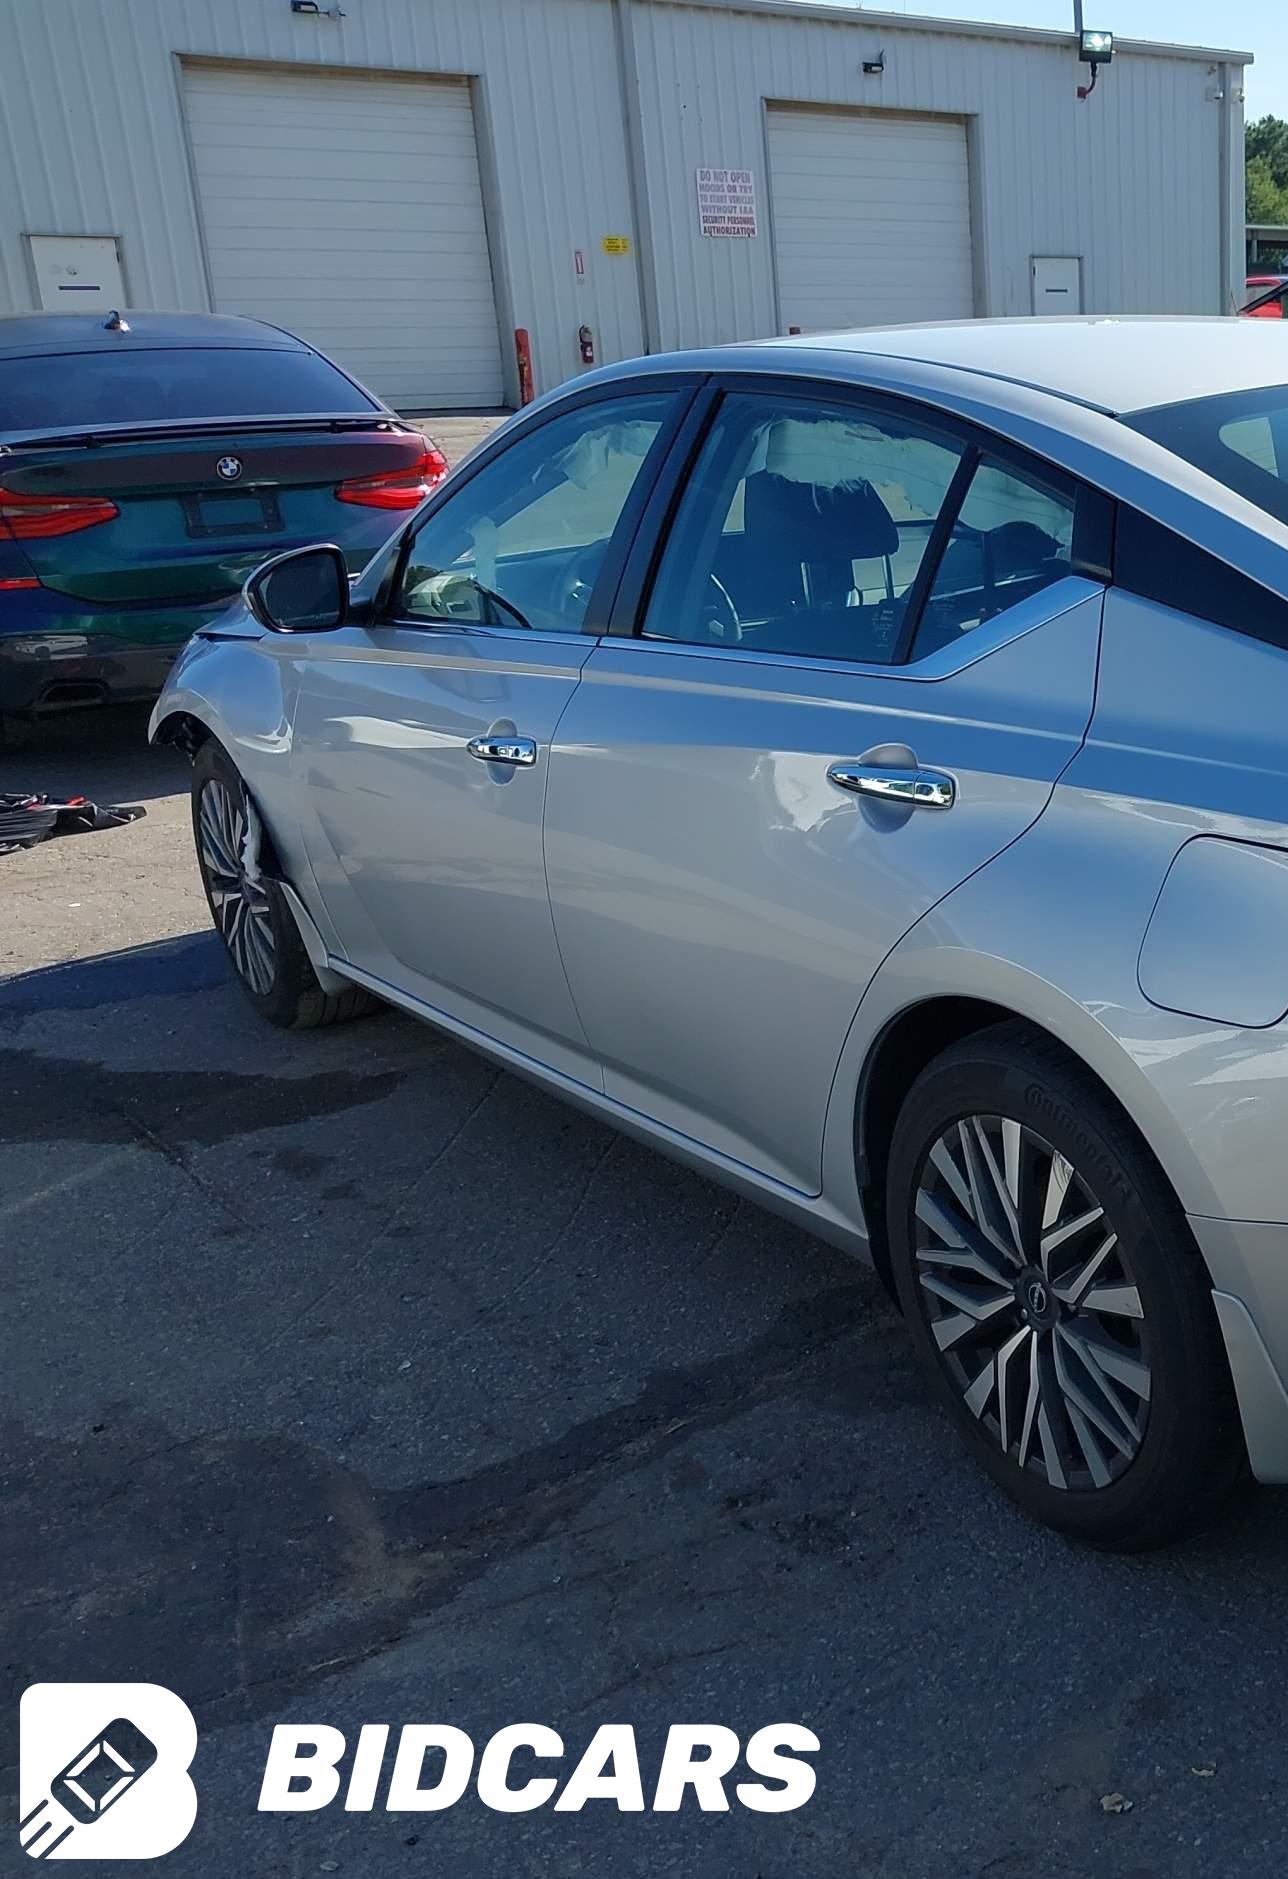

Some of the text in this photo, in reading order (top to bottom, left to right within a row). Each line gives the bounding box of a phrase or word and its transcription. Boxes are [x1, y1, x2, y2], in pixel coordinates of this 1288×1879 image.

[699, 170, 751, 184] DO NOT OPEN
[699, 183, 753, 194] HOODS OR TRY
[700, 193, 709, 203] TO
[701, 204, 737, 215] WITHOUT
[702, 215, 726, 225] SECURITY
[703, 225, 756, 236] AUTHORIZATION
[1024, 1083, 1123, 1187] Continental
